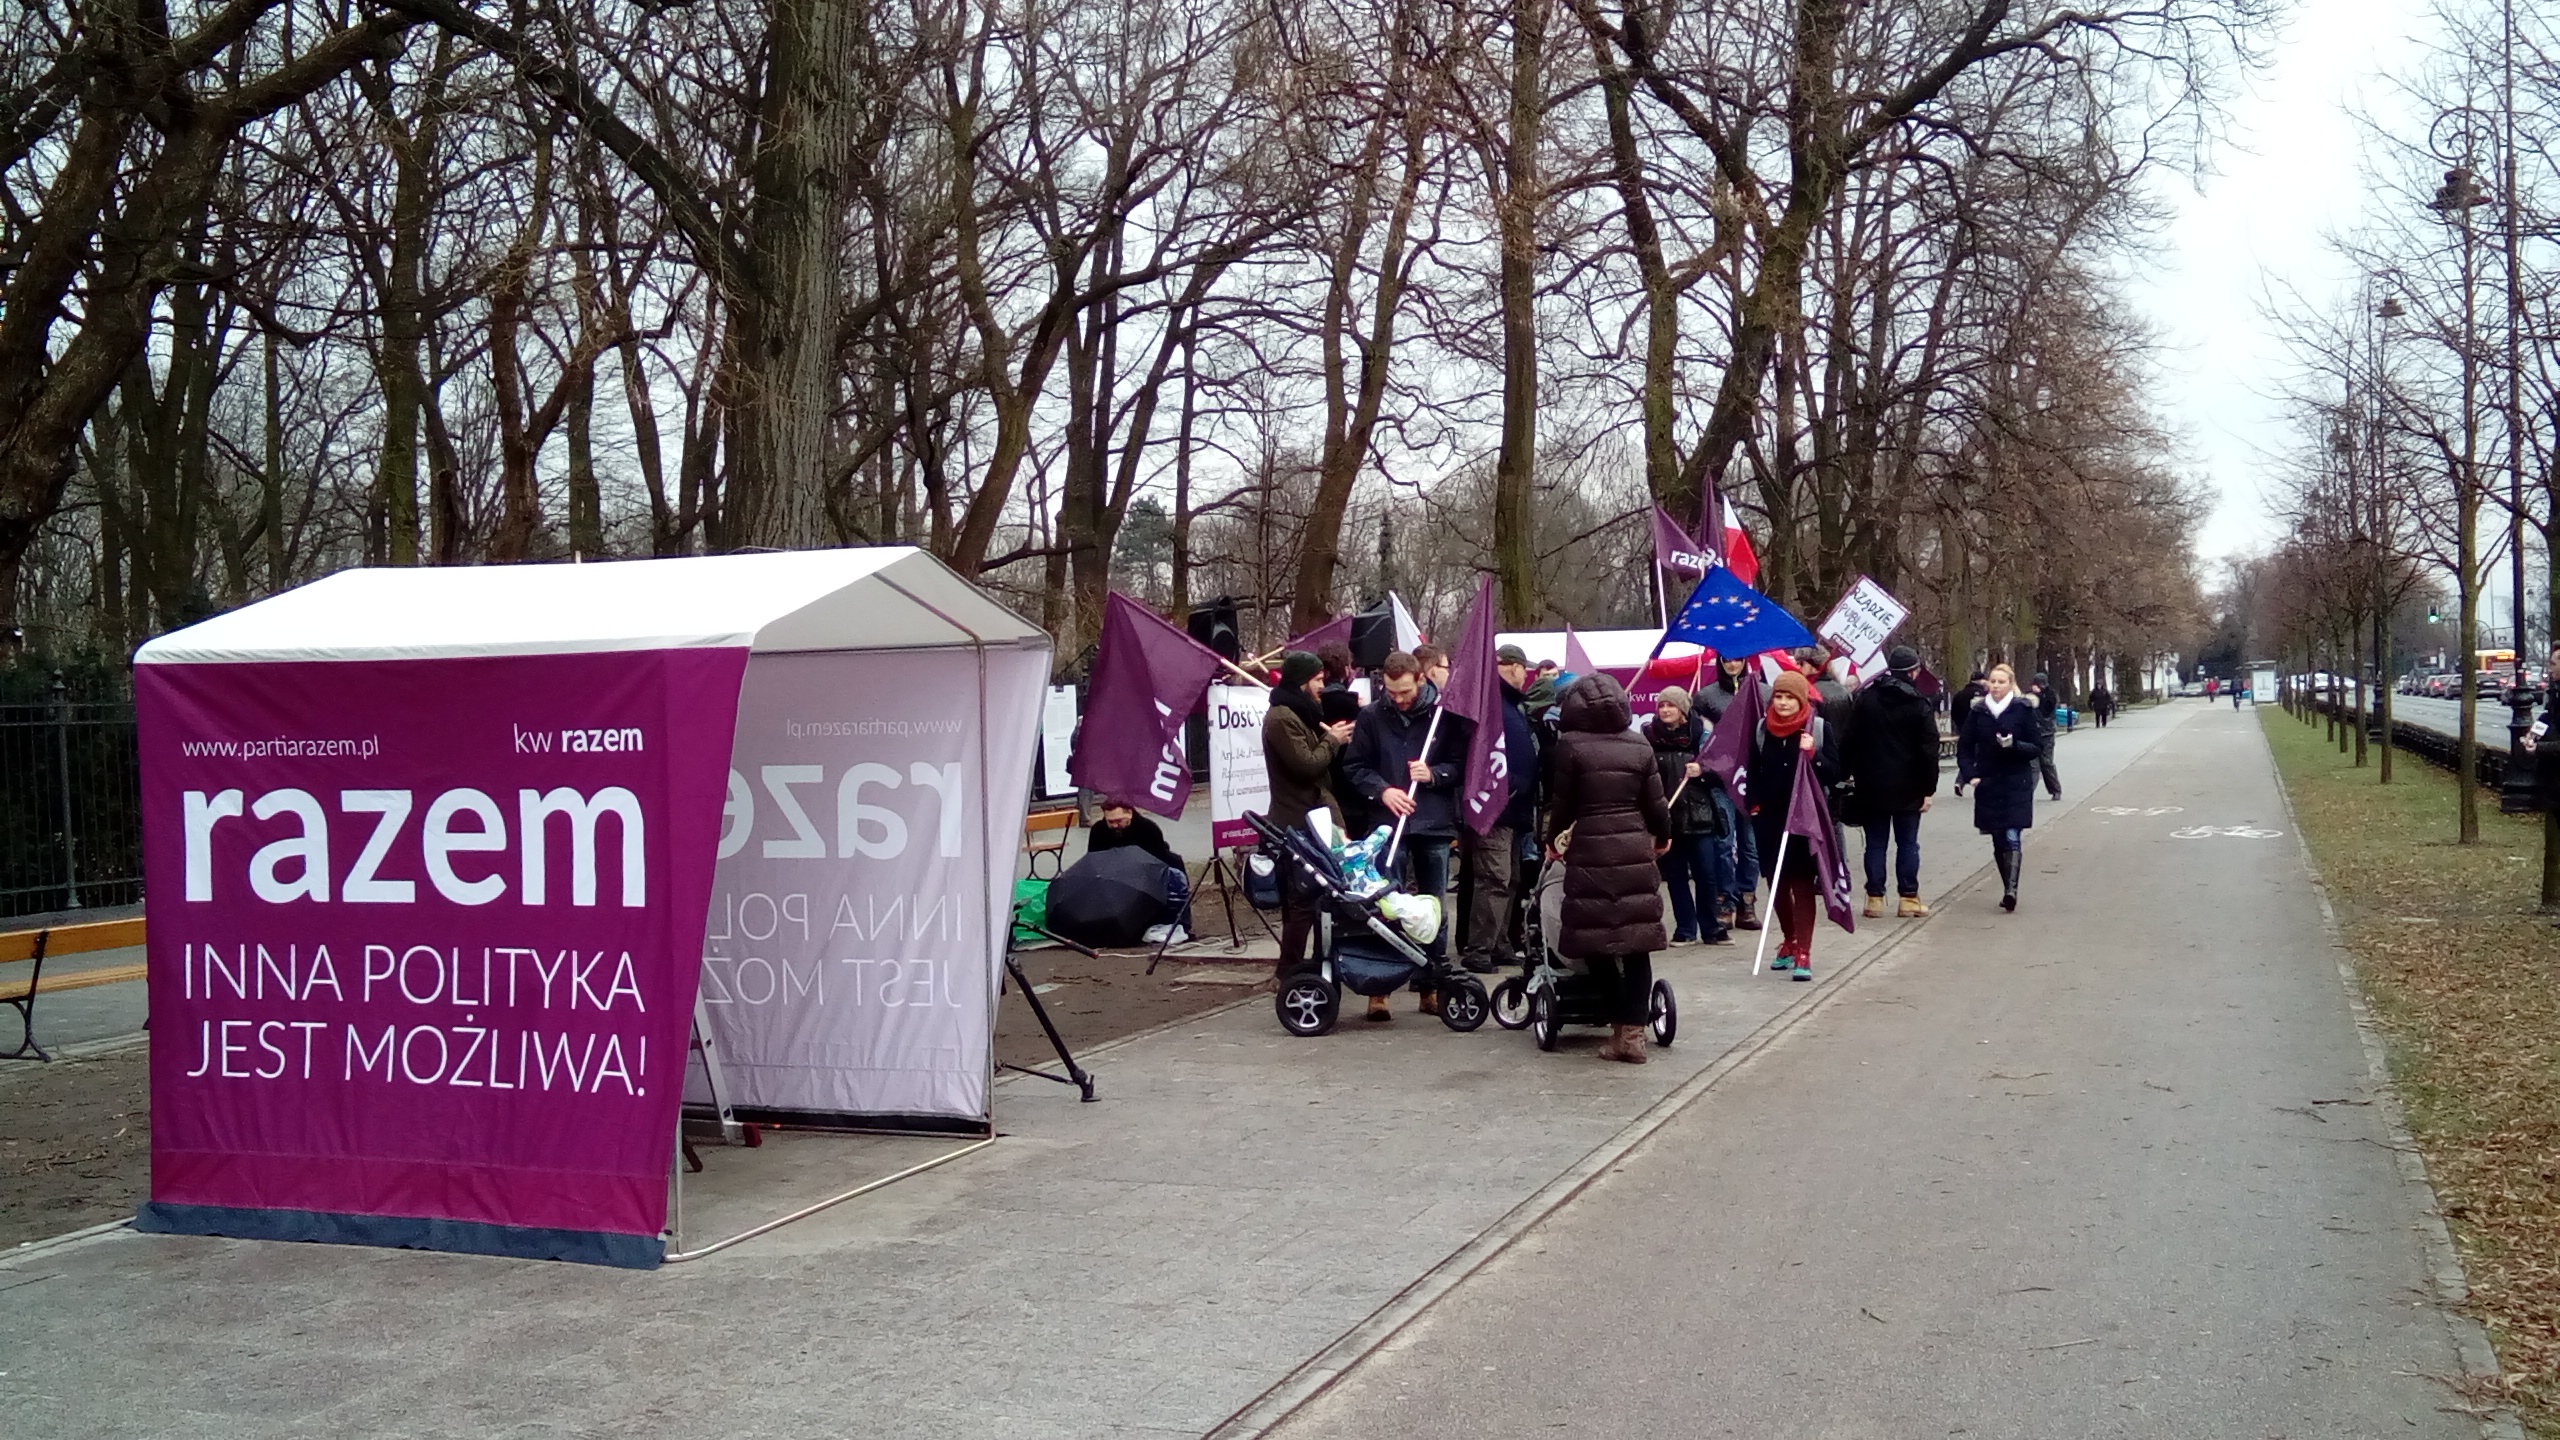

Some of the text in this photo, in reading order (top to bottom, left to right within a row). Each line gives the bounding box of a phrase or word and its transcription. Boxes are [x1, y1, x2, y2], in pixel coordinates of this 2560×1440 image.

[182, 724, 644, 762] www.partiarazem.pl kw razem
[1218, 704, 1255, 730] Dość
[182, 786, 646, 908] razem
[184, 943, 646, 1013] INNA POLITYKA
[186, 1014, 646, 1096] JEST MOŻLIWA!
